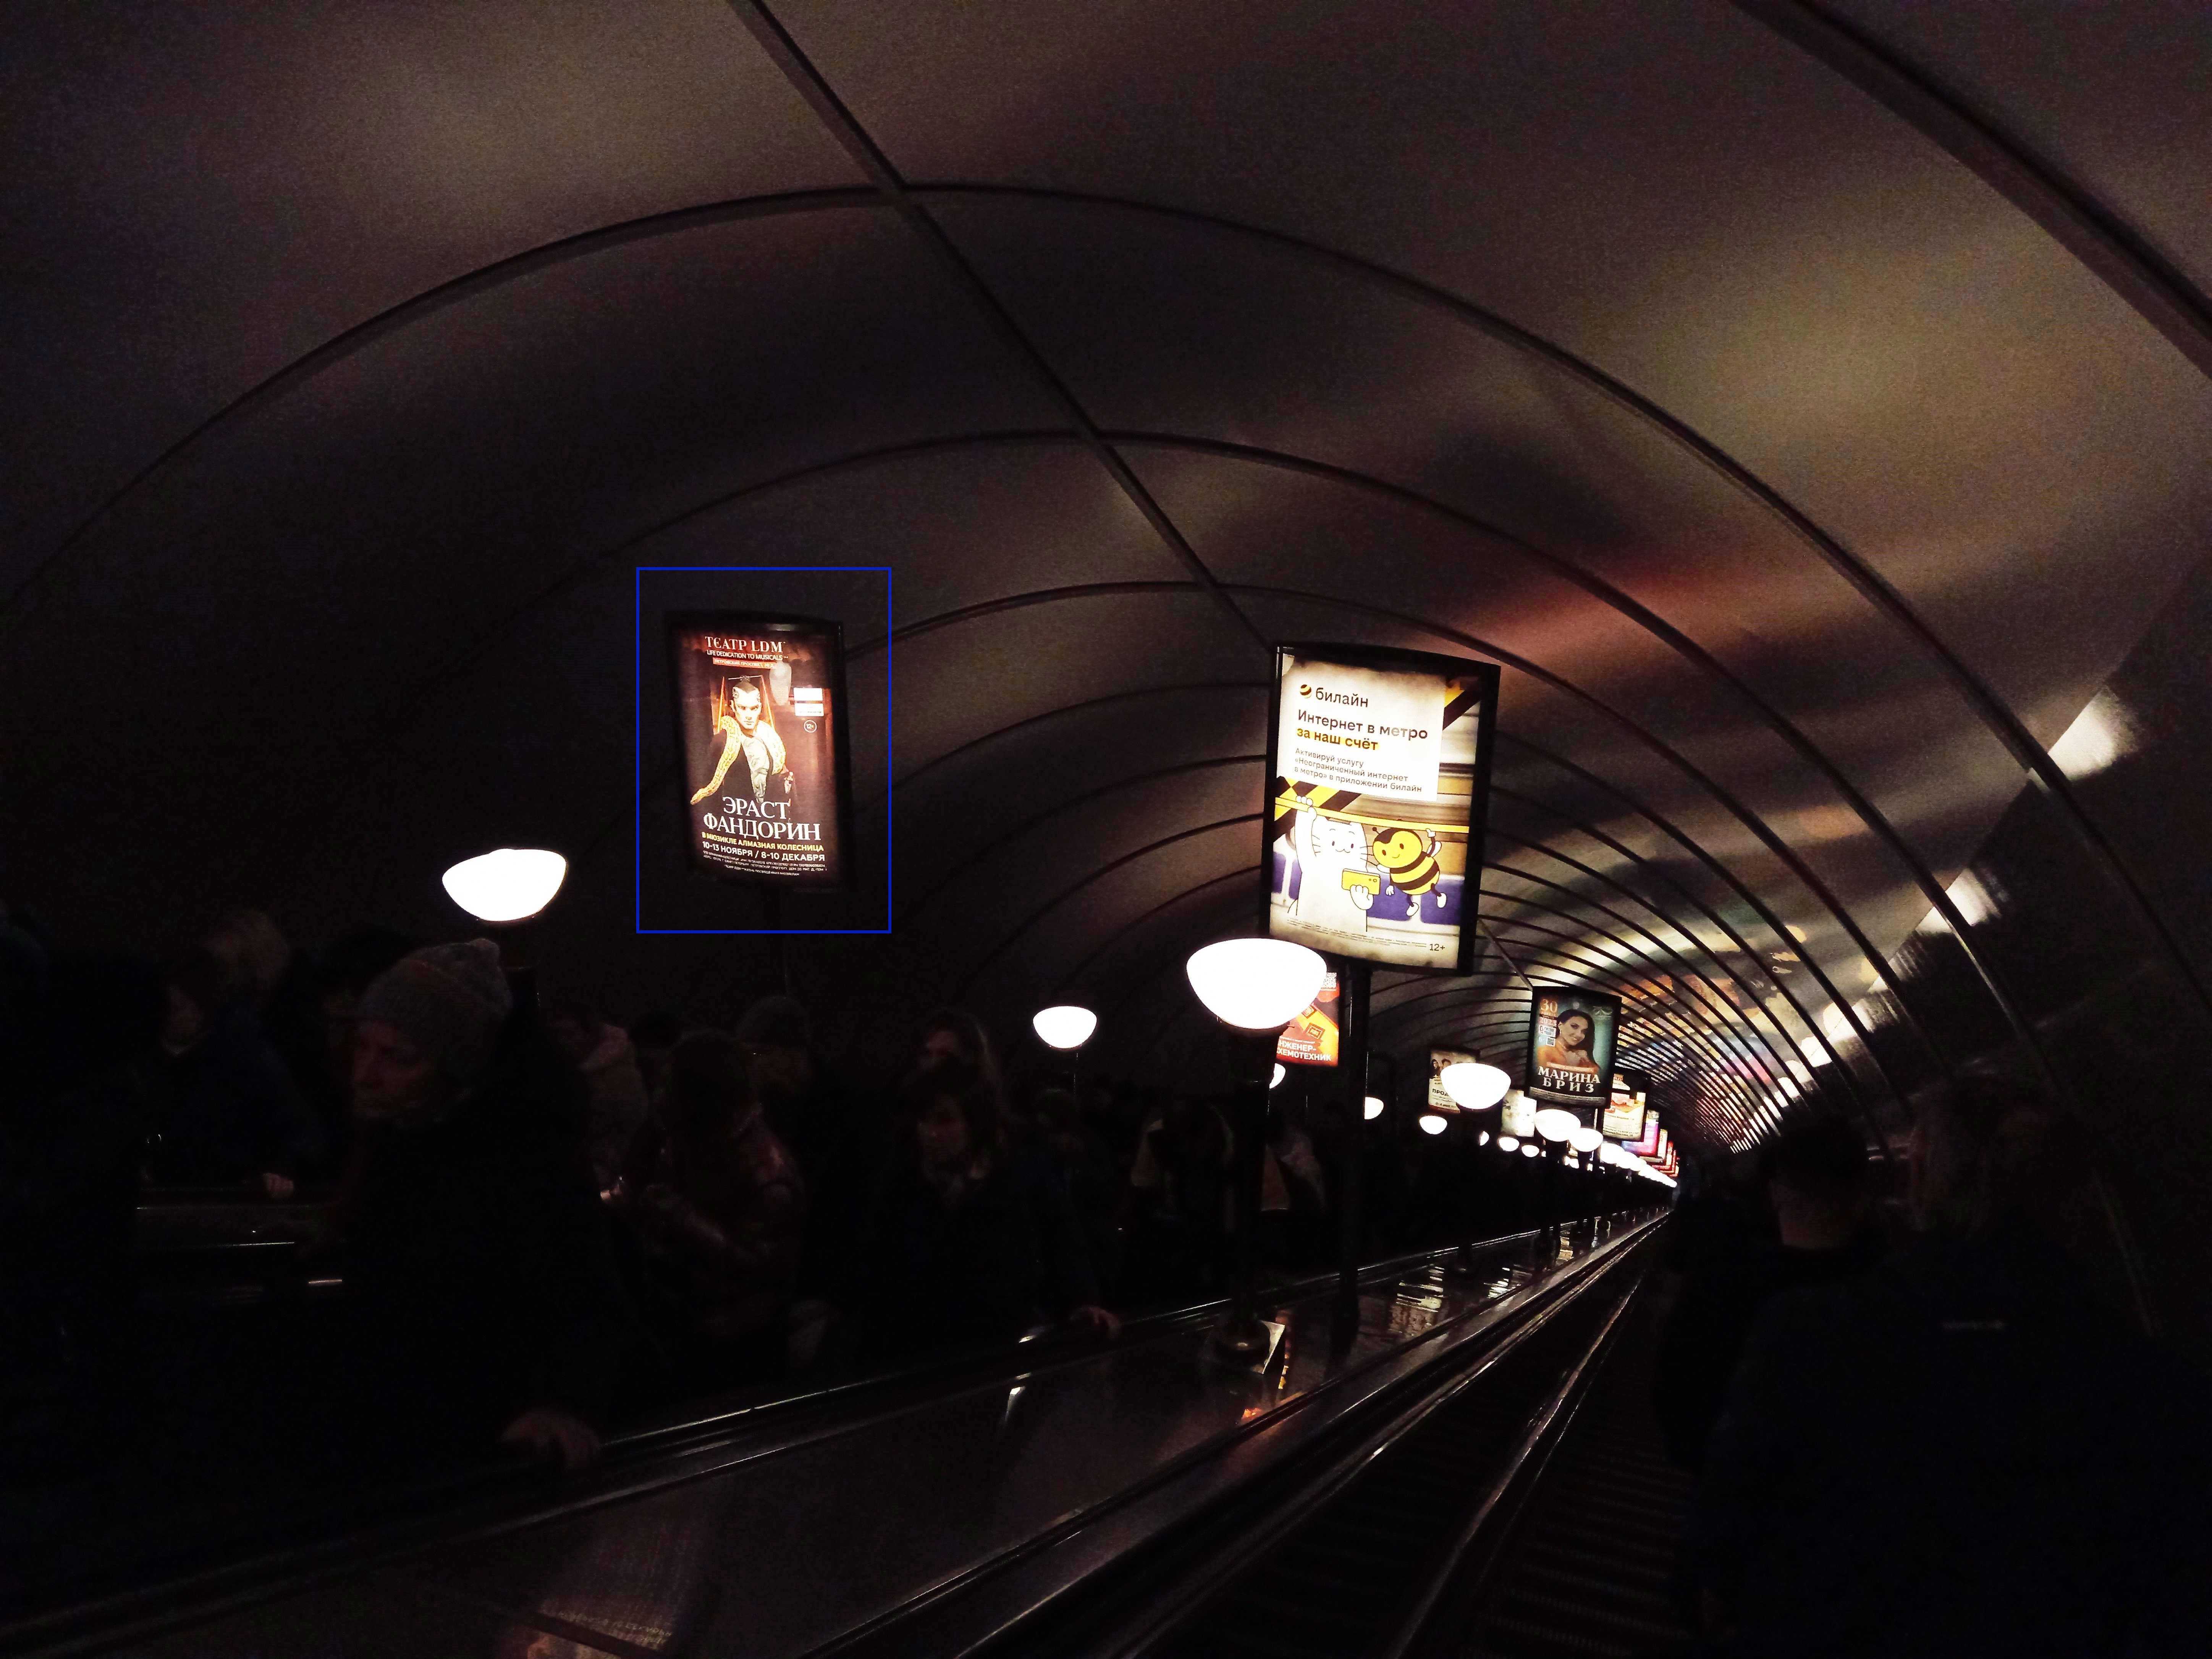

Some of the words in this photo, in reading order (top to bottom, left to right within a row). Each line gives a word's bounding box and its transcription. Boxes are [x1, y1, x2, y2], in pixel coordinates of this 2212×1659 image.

[705, 637, 747, 650] ТЕАТР
[716, 650, 746, 659] DEDICATION
[1316, 687, 1368, 707] билайн
[1298, 709, 1363, 732] Интернет
[1368, 724, 1374, 734] в
[1379, 726, 1428, 741] метро
[1297, 728, 1310, 738] за
[1314, 732, 1340, 745] наш
[1345, 738, 1378, 750] счёт
[1295, 748, 1335, 762] Активируй
[1337, 758, 1364, 768] услугу
[1295, 757, 1365, 776] «Неограниченный
[1368, 771, 1408, 781] интернет
[1300, 767, 1327, 778] метро»
[1336, 776, 1387, 789] приложении
[1391, 783, 1422, 792] билайн
[722, 796, 789, 819] ЭРАСТ
[703, 812, 821, 840] ФАНДОРИН
[702, 841, 719, 851] 10-13
[721, 844, 753, 857] НОЯБРЯ
[755, 850, 759, 859] /
[761, 851, 779, 860] 8-10
[782, 853, 825, 862] ДЕКАБРЯ
[707, 832, 737, 845] МЮЗИКЛЕ
[738, 838, 775, 850] АЛМАЗНАЯ
[777, 843, 824, 852] КОЛЕСНИЦА
[1429, 943, 1445, 951] 12+
[1541, 999, 1558, 1013] 30
[1277, 1047, 1332, 1061] ХЕМОТЕХНИК
[1278, 1040, 1317, 1051] НЖЕНЕР-
[1538, 1066, 1601, 1083] МАРИНА
[1543, 1077, 1594, 1093] БРИЗ
